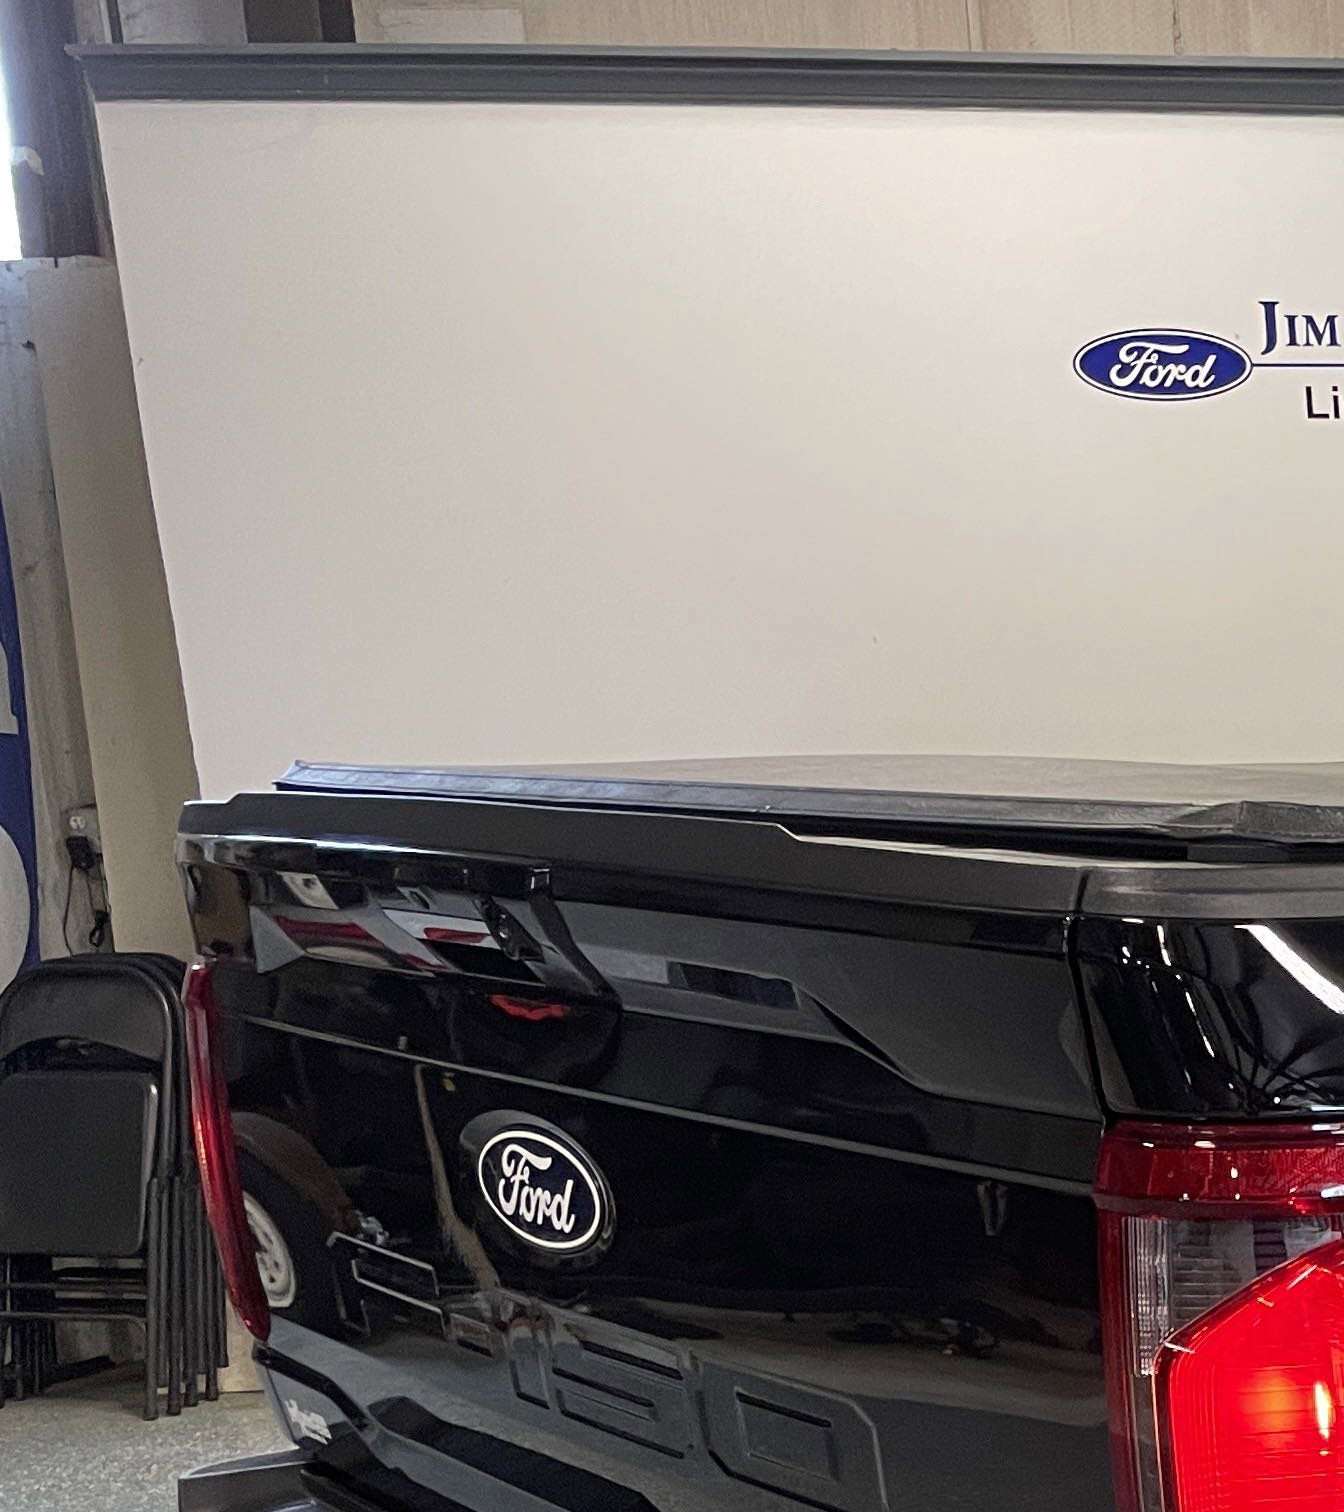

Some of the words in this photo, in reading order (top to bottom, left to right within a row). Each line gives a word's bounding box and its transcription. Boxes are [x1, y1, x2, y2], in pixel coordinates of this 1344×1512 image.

[1258, 300, 1339, 356] JIM
[1109, 341, 1215, 390] Ford
[498, 1142, 576, 1234] Ford
